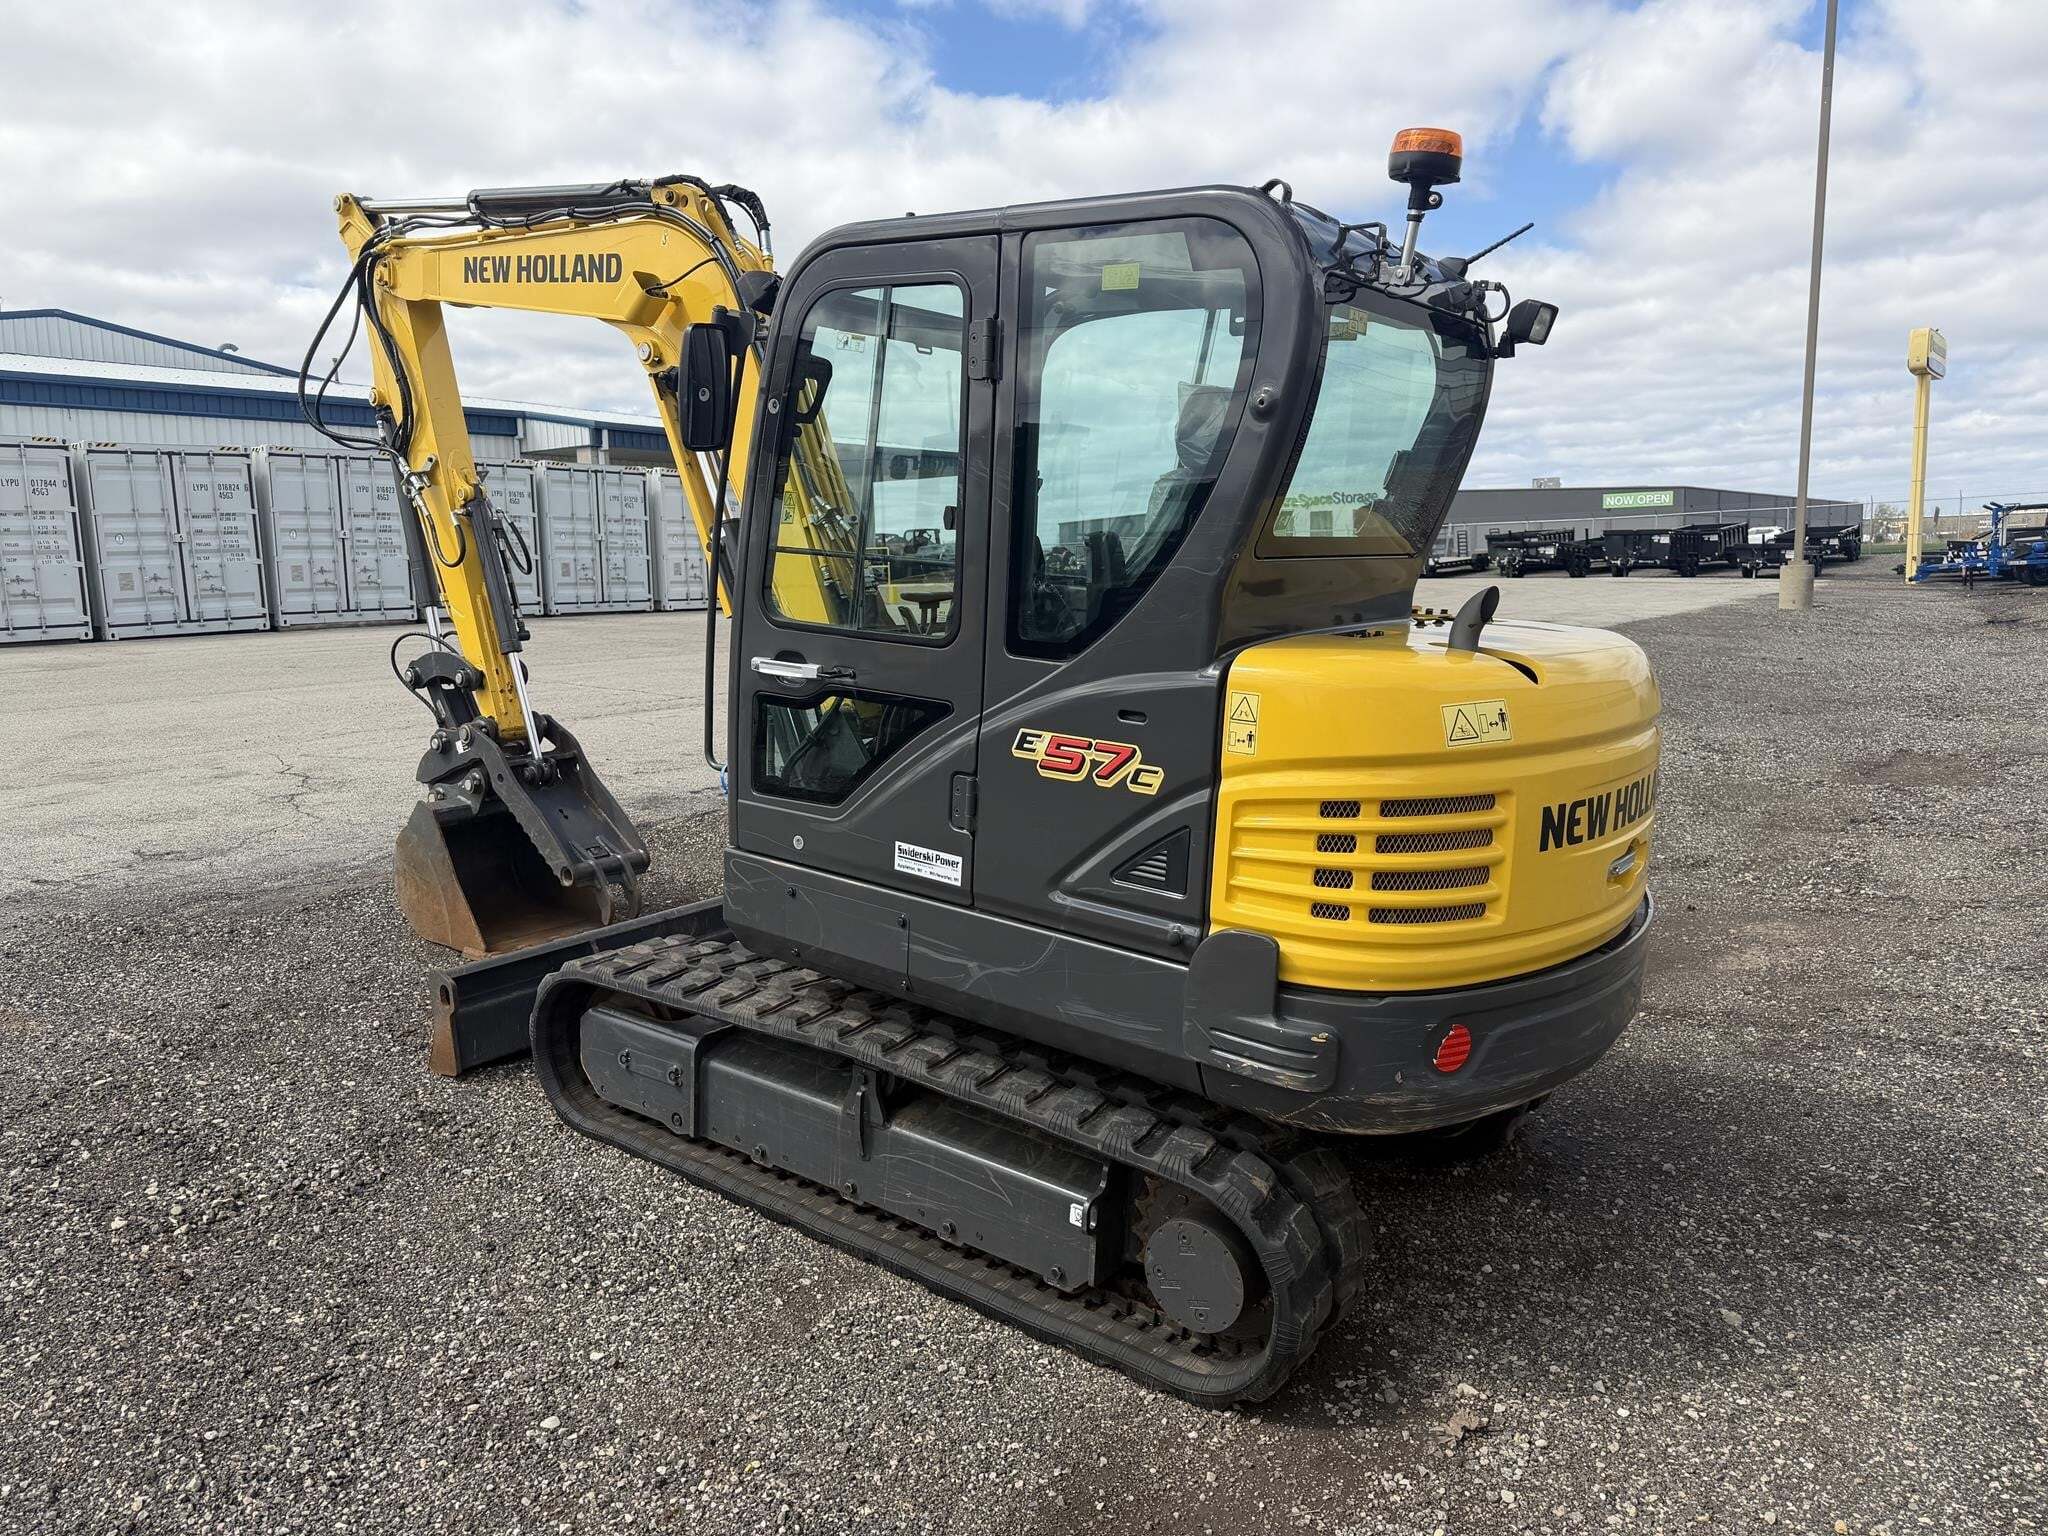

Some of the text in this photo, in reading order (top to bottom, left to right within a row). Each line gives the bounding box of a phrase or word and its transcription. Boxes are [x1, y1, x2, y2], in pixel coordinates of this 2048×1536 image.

[464, 253, 622, 284] NEW HOLLAND
[0, 478, 20, 487] LYPU
[1606, 493, 1670, 506] NOW OPEN
[1539, 791, 1612, 853] NEW
[897, 844, 934, 863] Swiderski
[934, 853, 960, 869] Power
